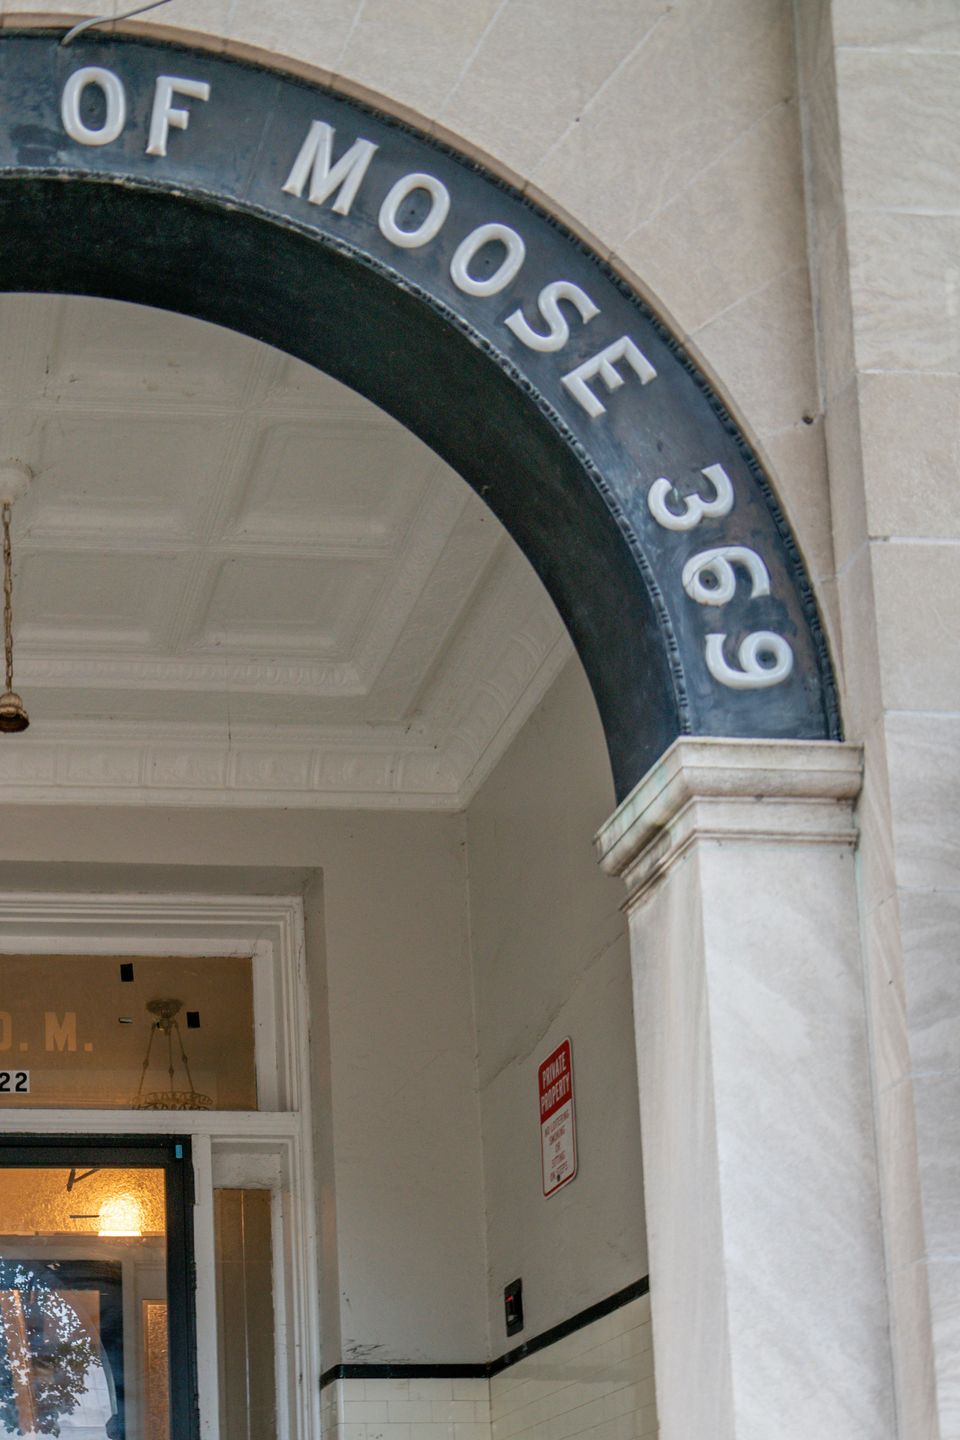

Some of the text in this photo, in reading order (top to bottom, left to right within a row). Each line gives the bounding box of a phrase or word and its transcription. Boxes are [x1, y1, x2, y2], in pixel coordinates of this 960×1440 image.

[60, 65, 211, 157] OF
[281, 120, 657, 418] MOOSE
[647, 463, 795, 690] 369
[542, 1051, 566, 1090] PRIVATE
[541, 1072, 570, 1116] PROPERTY
